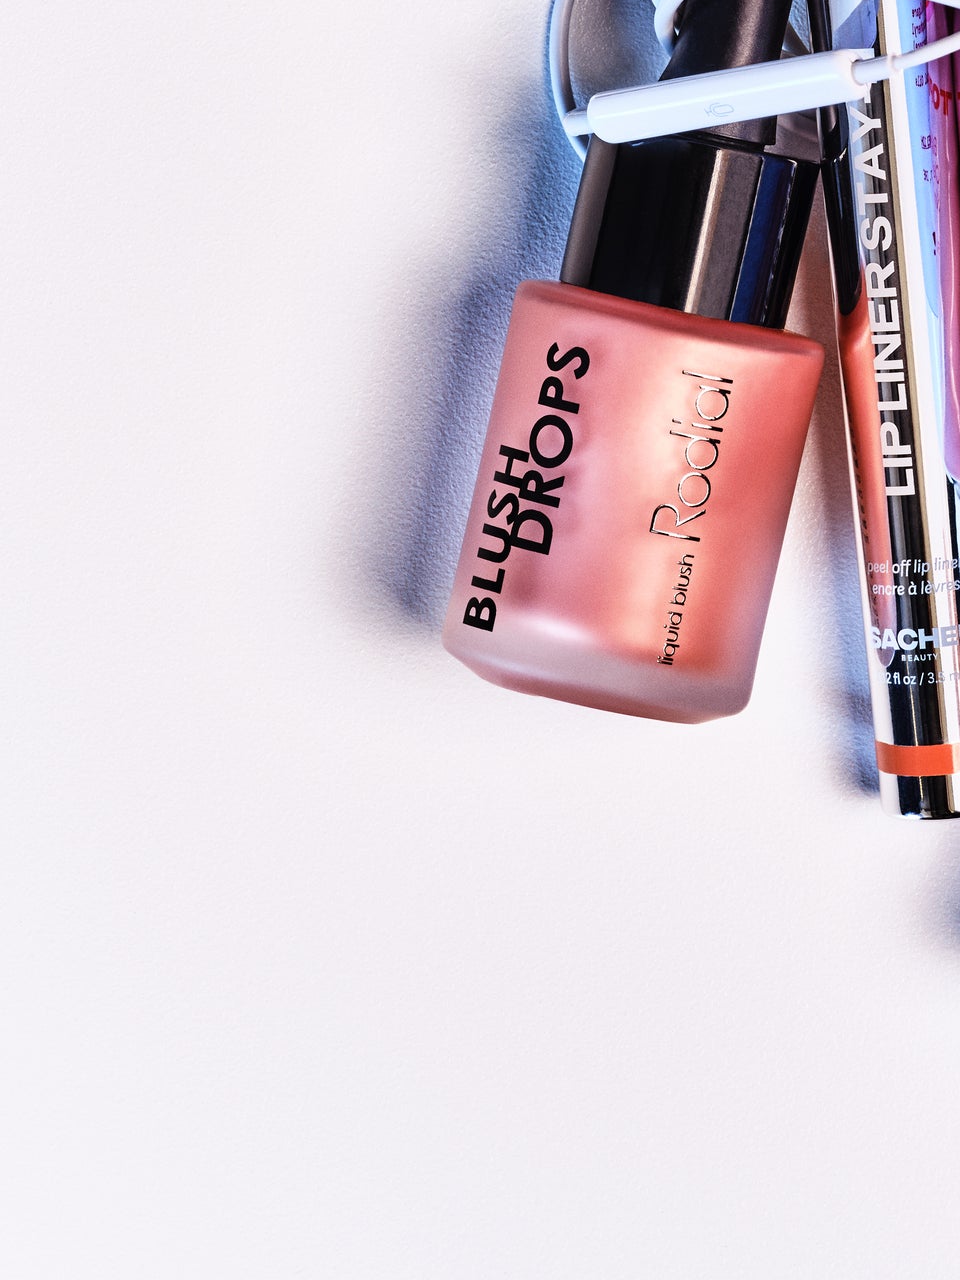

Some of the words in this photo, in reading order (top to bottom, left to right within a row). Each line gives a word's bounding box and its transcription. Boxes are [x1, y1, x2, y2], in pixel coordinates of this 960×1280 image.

[864, 260, 910, 411] LINER
[510, 341, 591, 556] DROPS
[649, 369, 734, 543] Rodial
[879, 421, 917, 497] LIP
[462, 444, 531, 632] BLUSH
[867, 560, 889, 573] peel
[891, 559, 912, 577] off
[913, 558, 931, 576] lip
[656, 610, 684, 666] liquid
[670, 553, 695, 609] blush
[872, 584, 905, 596] encre
[908, 581, 918, 595] à
[920, 579, 960, 595] lèvres
[893, 672, 901, 682] fl
[902, 675, 917, 685] oz
[901, 653, 938, 662] BEAUTY
